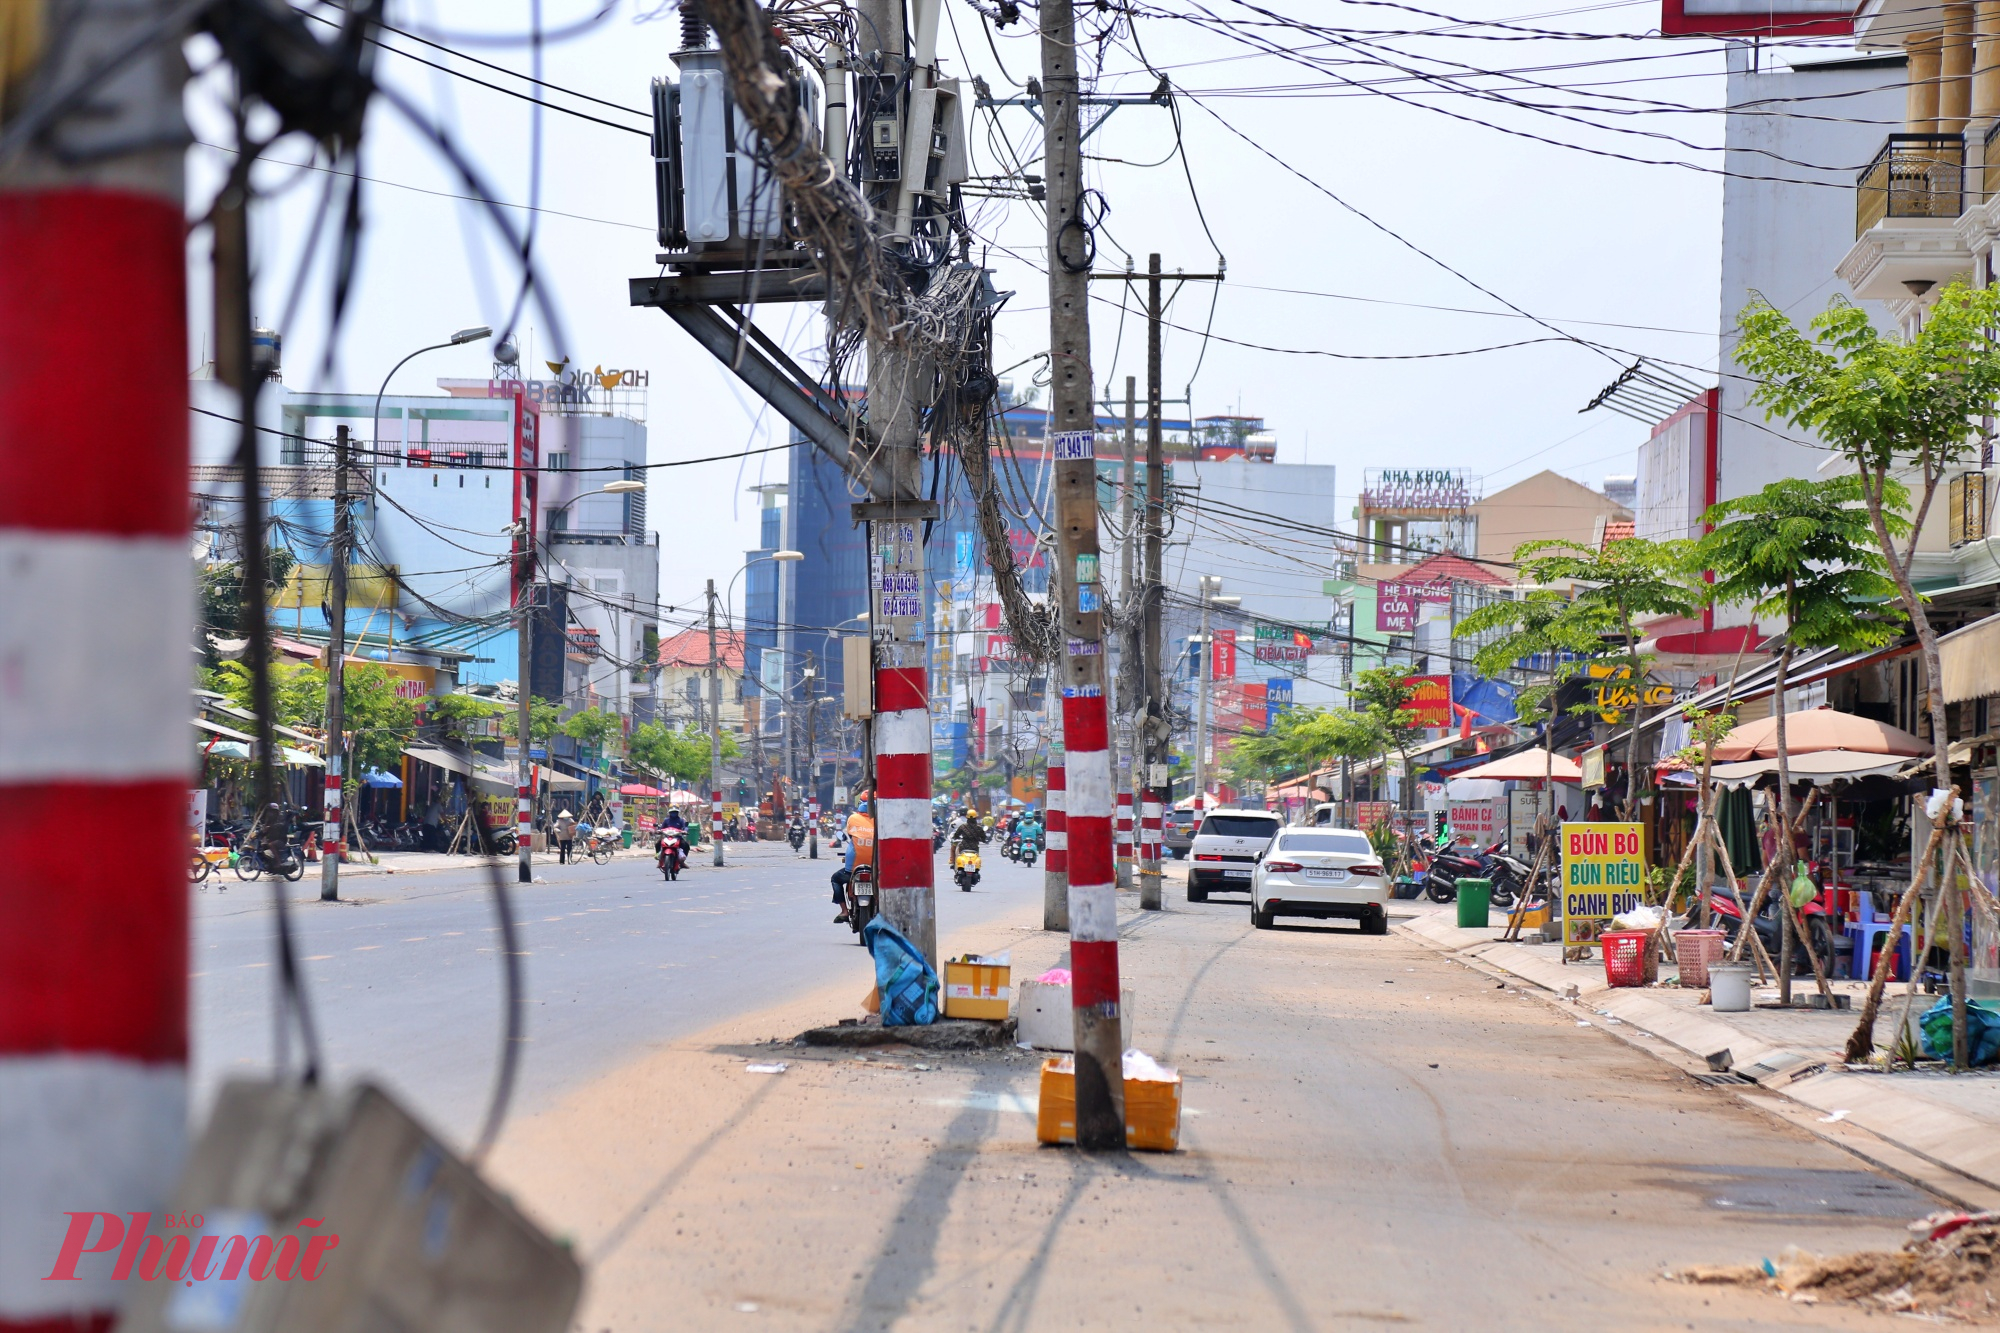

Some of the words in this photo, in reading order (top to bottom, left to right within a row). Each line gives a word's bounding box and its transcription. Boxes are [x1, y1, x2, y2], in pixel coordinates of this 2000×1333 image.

[488, 379, 593, 404] HDBank
[1383, 470, 1410, 482] NHA
[1416, 470, 1451, 482] KHOA
[1387, 617, 1406, 631] MẸ
[1451, 805, 1478, 821] BÁNH
[1569, 828, 1608, 856] BÚN
[1614, 827, 1640, 856] BÒ
[1569, 858, 1601, 886] BÚN
[1605, 858, 1640, 886] RIÊU
[1567, 893, 1608, 916] CANH
